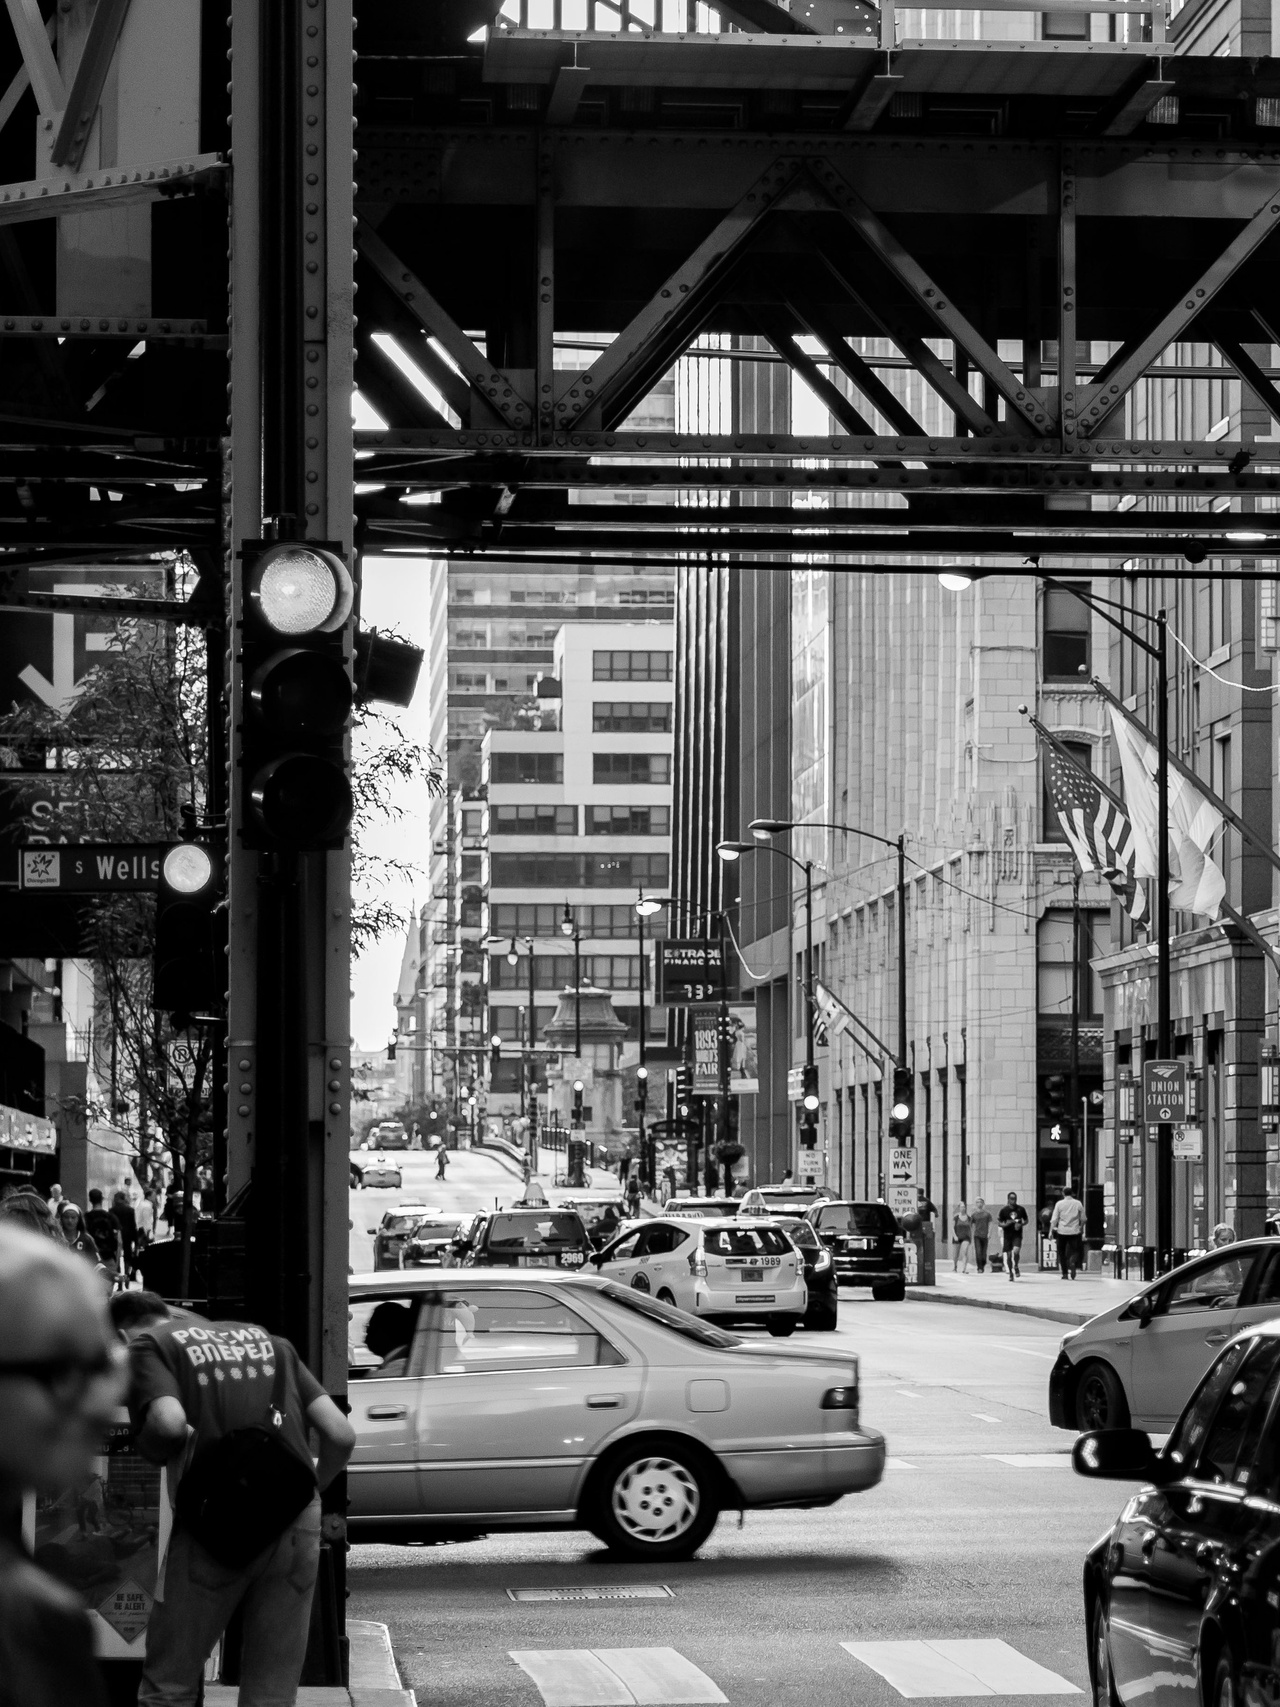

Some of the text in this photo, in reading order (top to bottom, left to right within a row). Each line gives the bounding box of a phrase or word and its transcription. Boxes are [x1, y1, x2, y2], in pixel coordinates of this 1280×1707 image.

[96, 855, 160, 880] Wells
[694, 1029, 718, 1049] 1893
[695, 1063, 718, 1075] FAIR
[1151, 1081, 1180, 1092] UNION
[1147, 1094, 1184, 1105] STATION
[893, 1150, 912, 1159] ONE
[892, 1160, 913, 1169] WAY
[561, 1252, 584, 1264] 2969
[760, 1257, 781, 1266] 1989
[186, 1340, 275, 1366] ВПЕРЕД
[116, 1593, 125, 1602] BE
